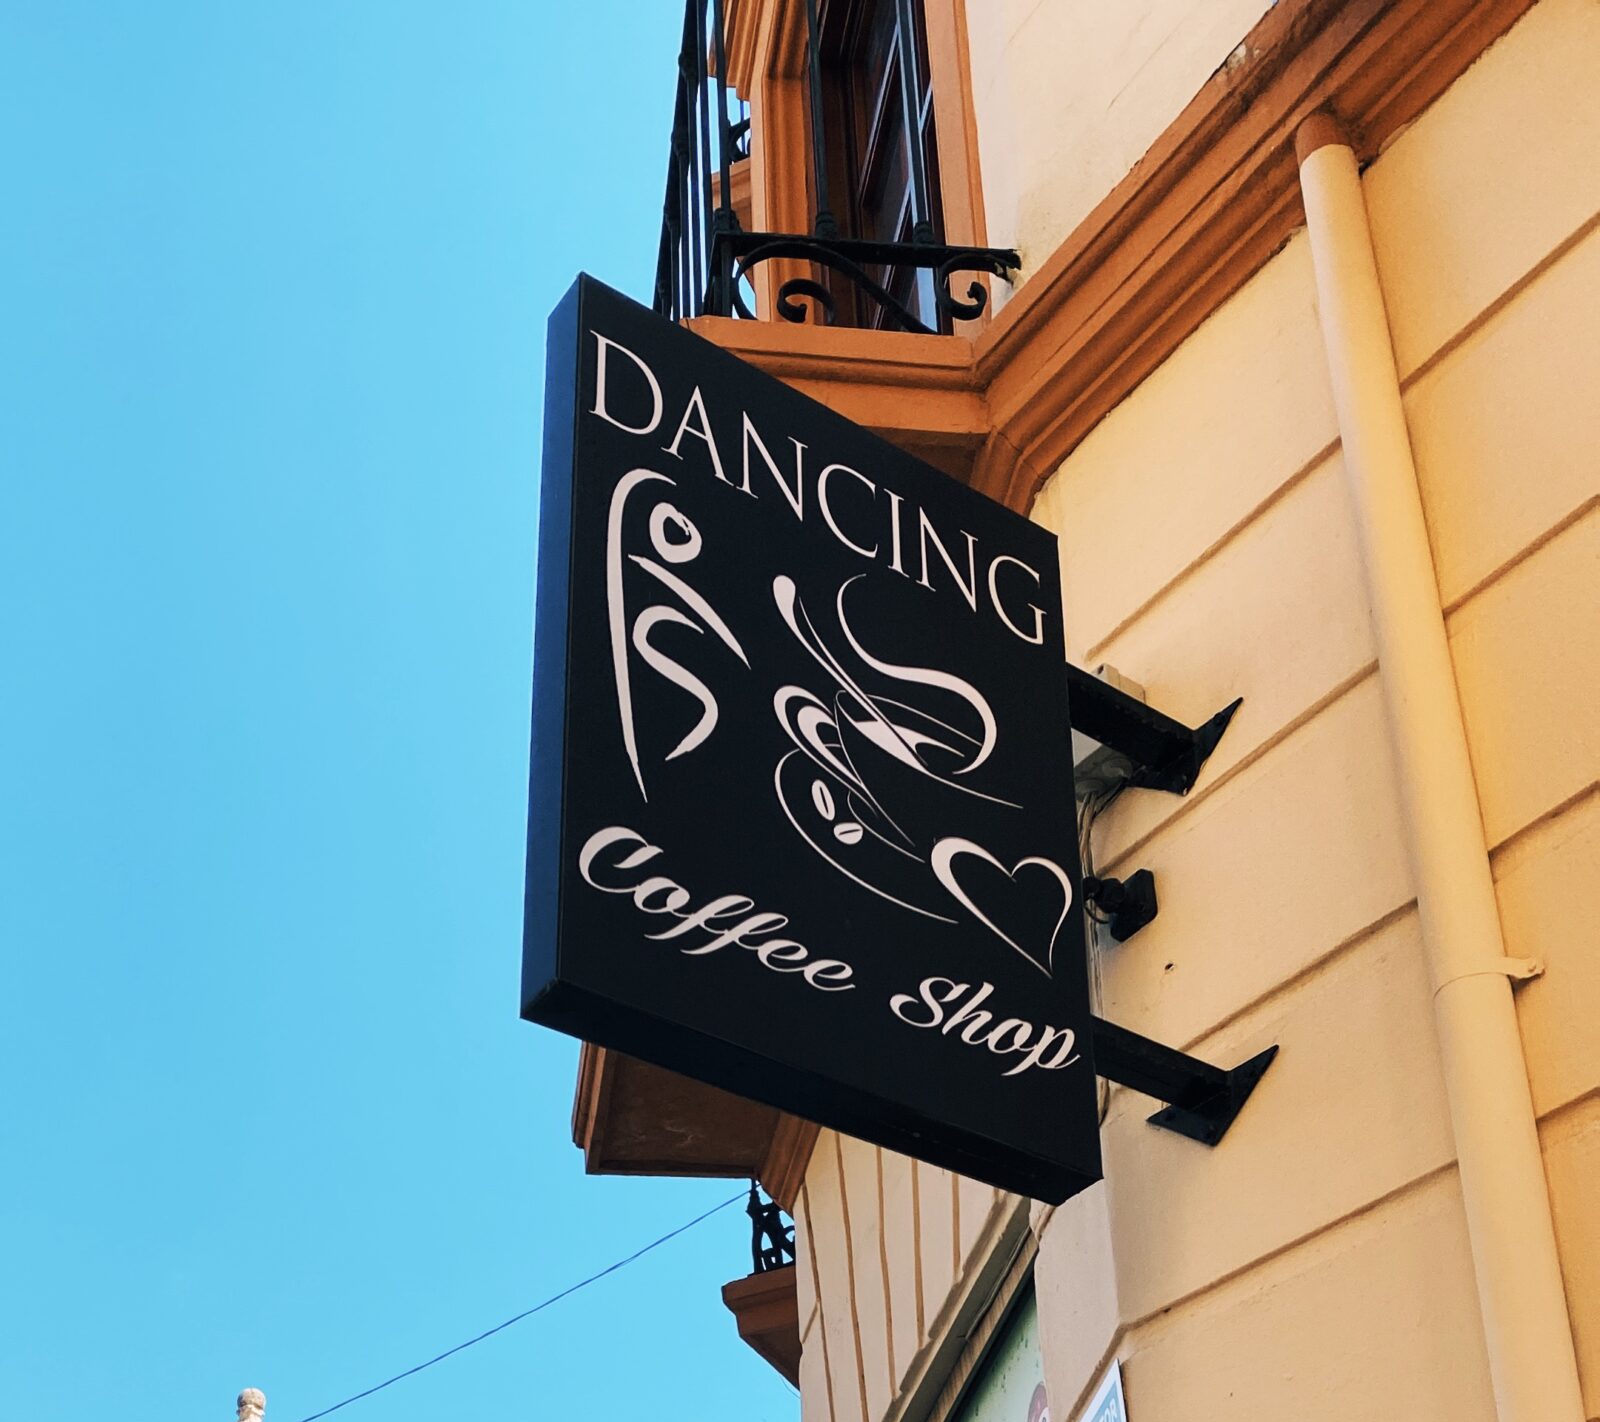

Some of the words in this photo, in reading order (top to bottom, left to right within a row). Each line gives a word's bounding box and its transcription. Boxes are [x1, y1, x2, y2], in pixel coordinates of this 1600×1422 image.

[590, 330, 1047, 645] DANCING
[579, 826, 856, 991] Coffee
[889, 974, 1081, 1076] Shop
